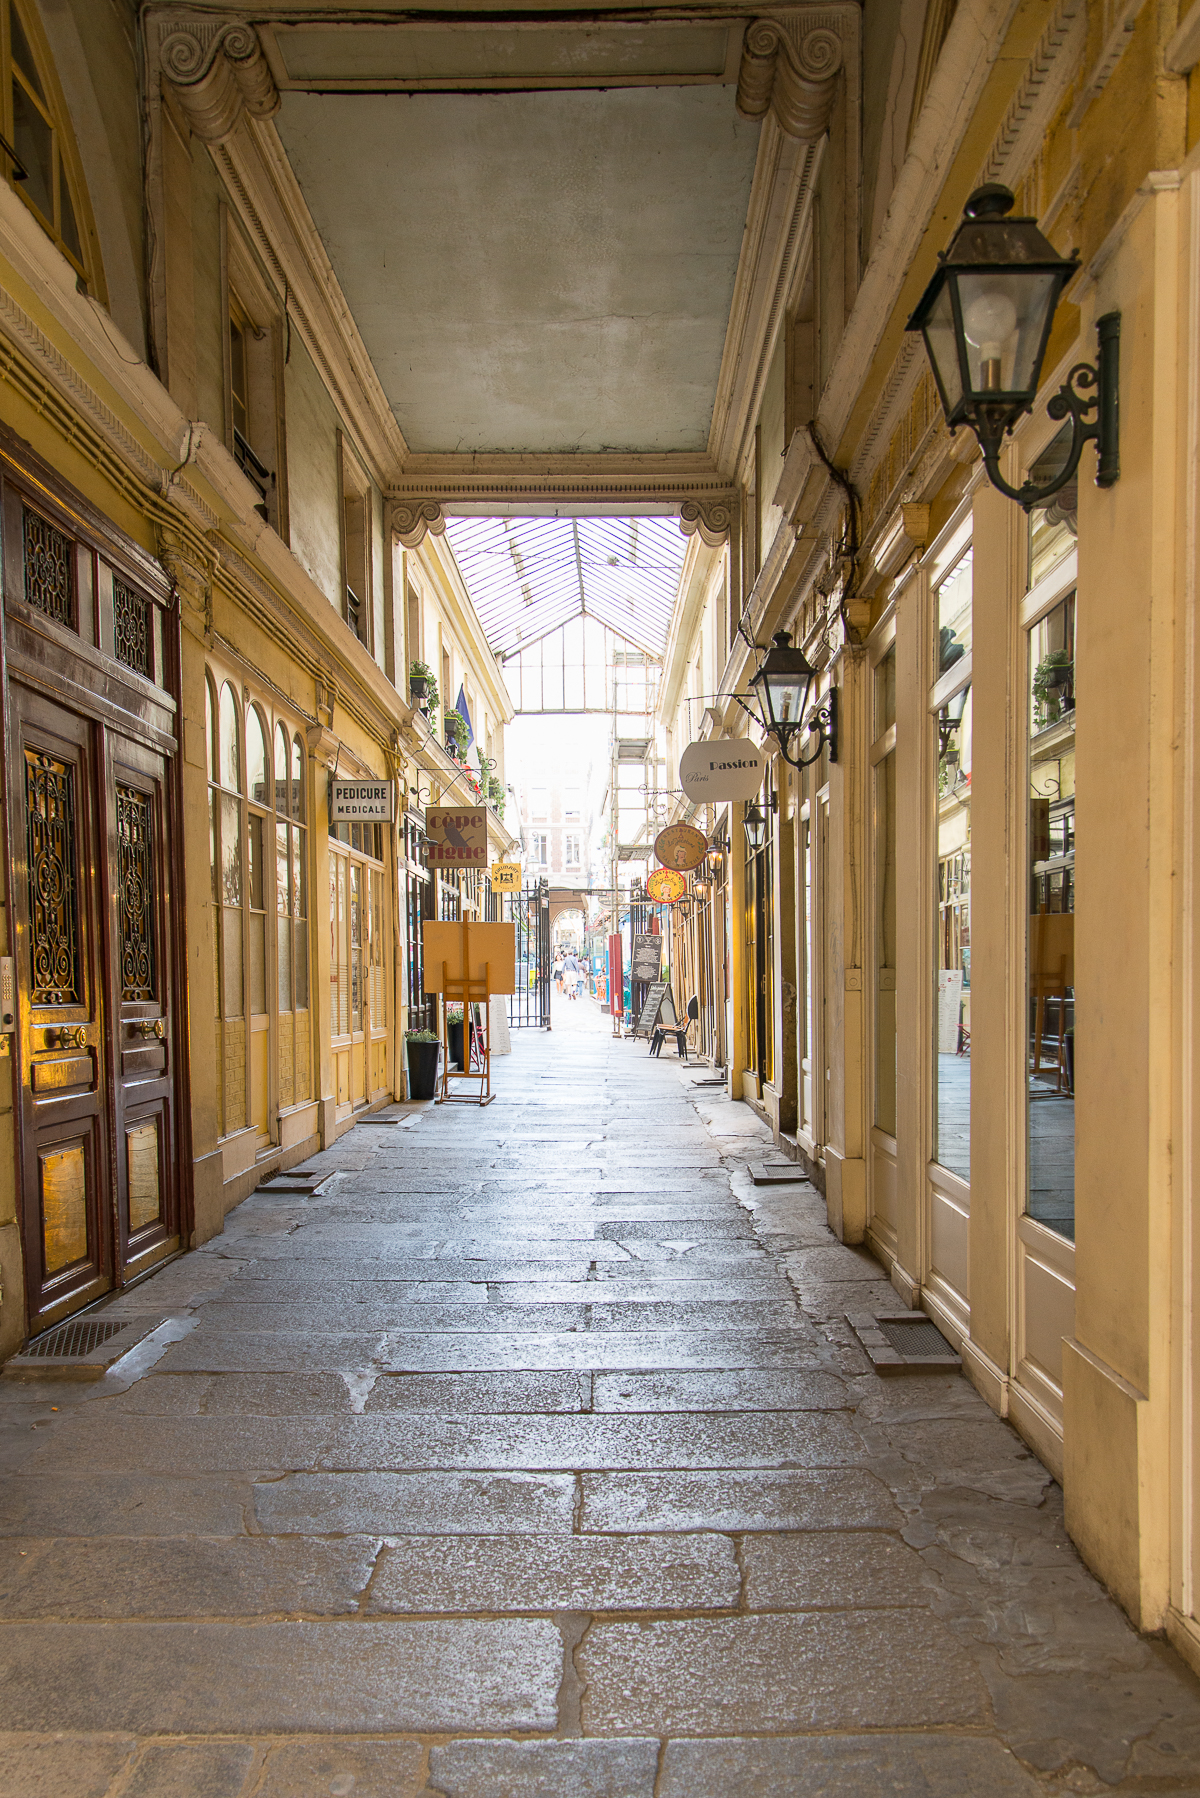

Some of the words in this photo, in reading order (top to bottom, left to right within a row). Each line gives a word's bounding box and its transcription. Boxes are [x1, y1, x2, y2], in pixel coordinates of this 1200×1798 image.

[709, 759, 758, 771] Passion
[685, 771, 709, 783] Paris
[336, 787, 387, 799] PEDICURE
[337, 805, 386, 813] MEDICALE
[429, 811, 483, 829] cèpe
